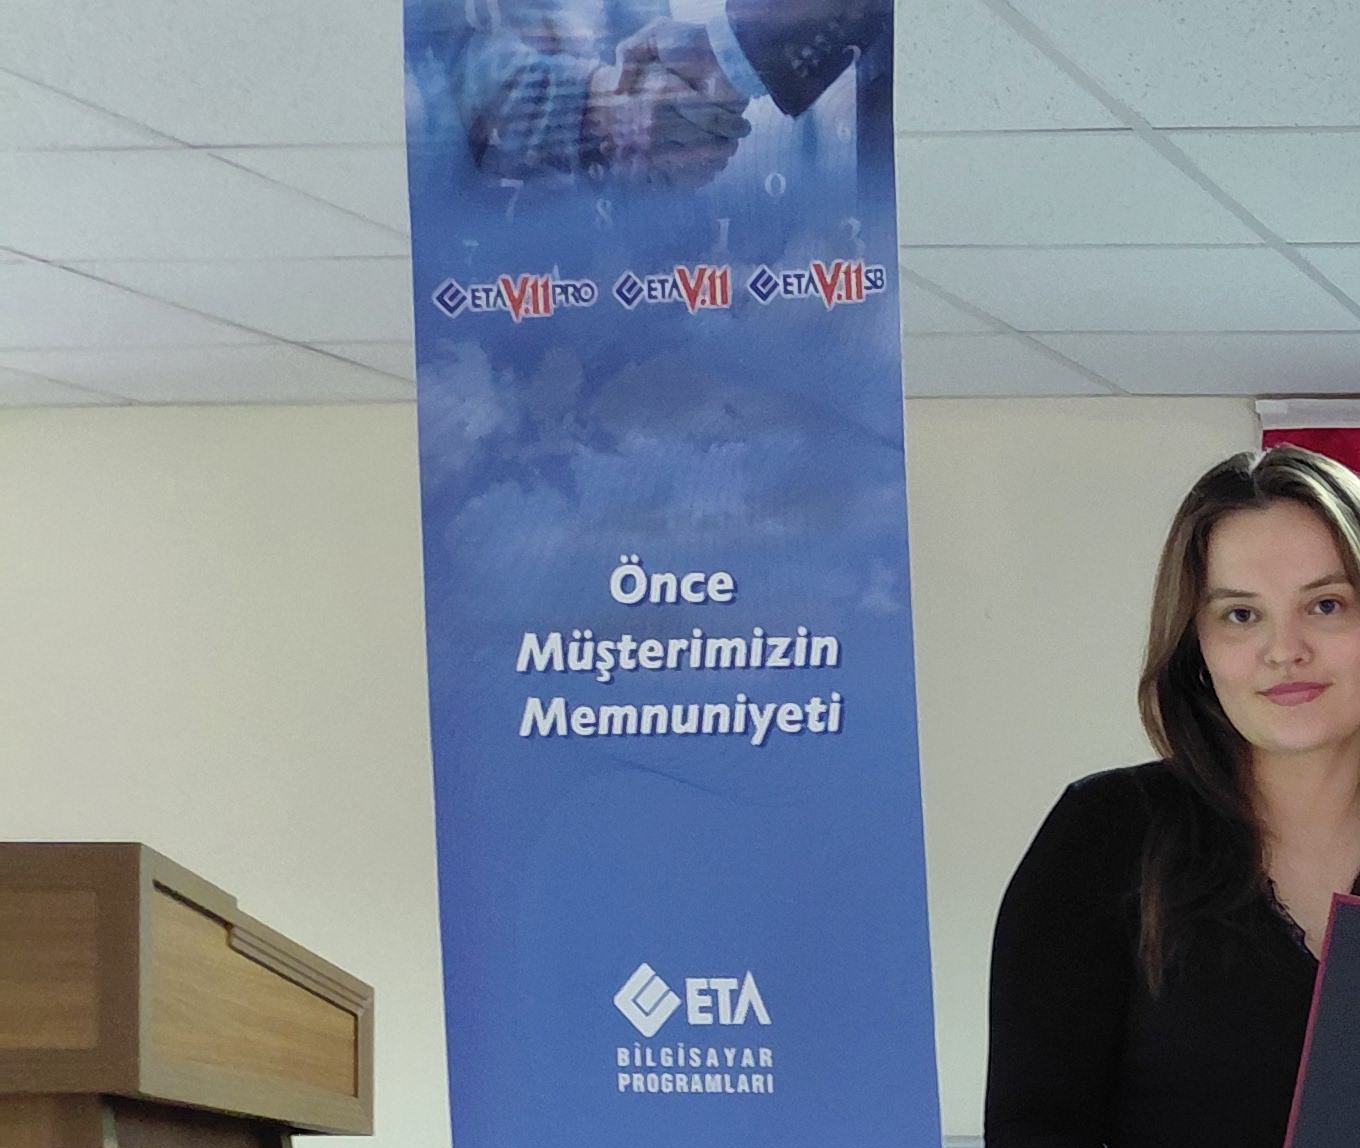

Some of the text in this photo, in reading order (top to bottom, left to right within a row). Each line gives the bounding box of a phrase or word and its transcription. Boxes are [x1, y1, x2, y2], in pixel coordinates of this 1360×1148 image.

[610, 554, 737, 605] Önce
[516, 626, 840, 683] Müşterimizin
[519, 691, 844, 746] Memnuniyeti
[685, 970, 773, 1026] ETA
[616, 1041, 774, 1068] BİLGİSAYAR
[617, 1072, 775, 1095] PROGRAMLARI
